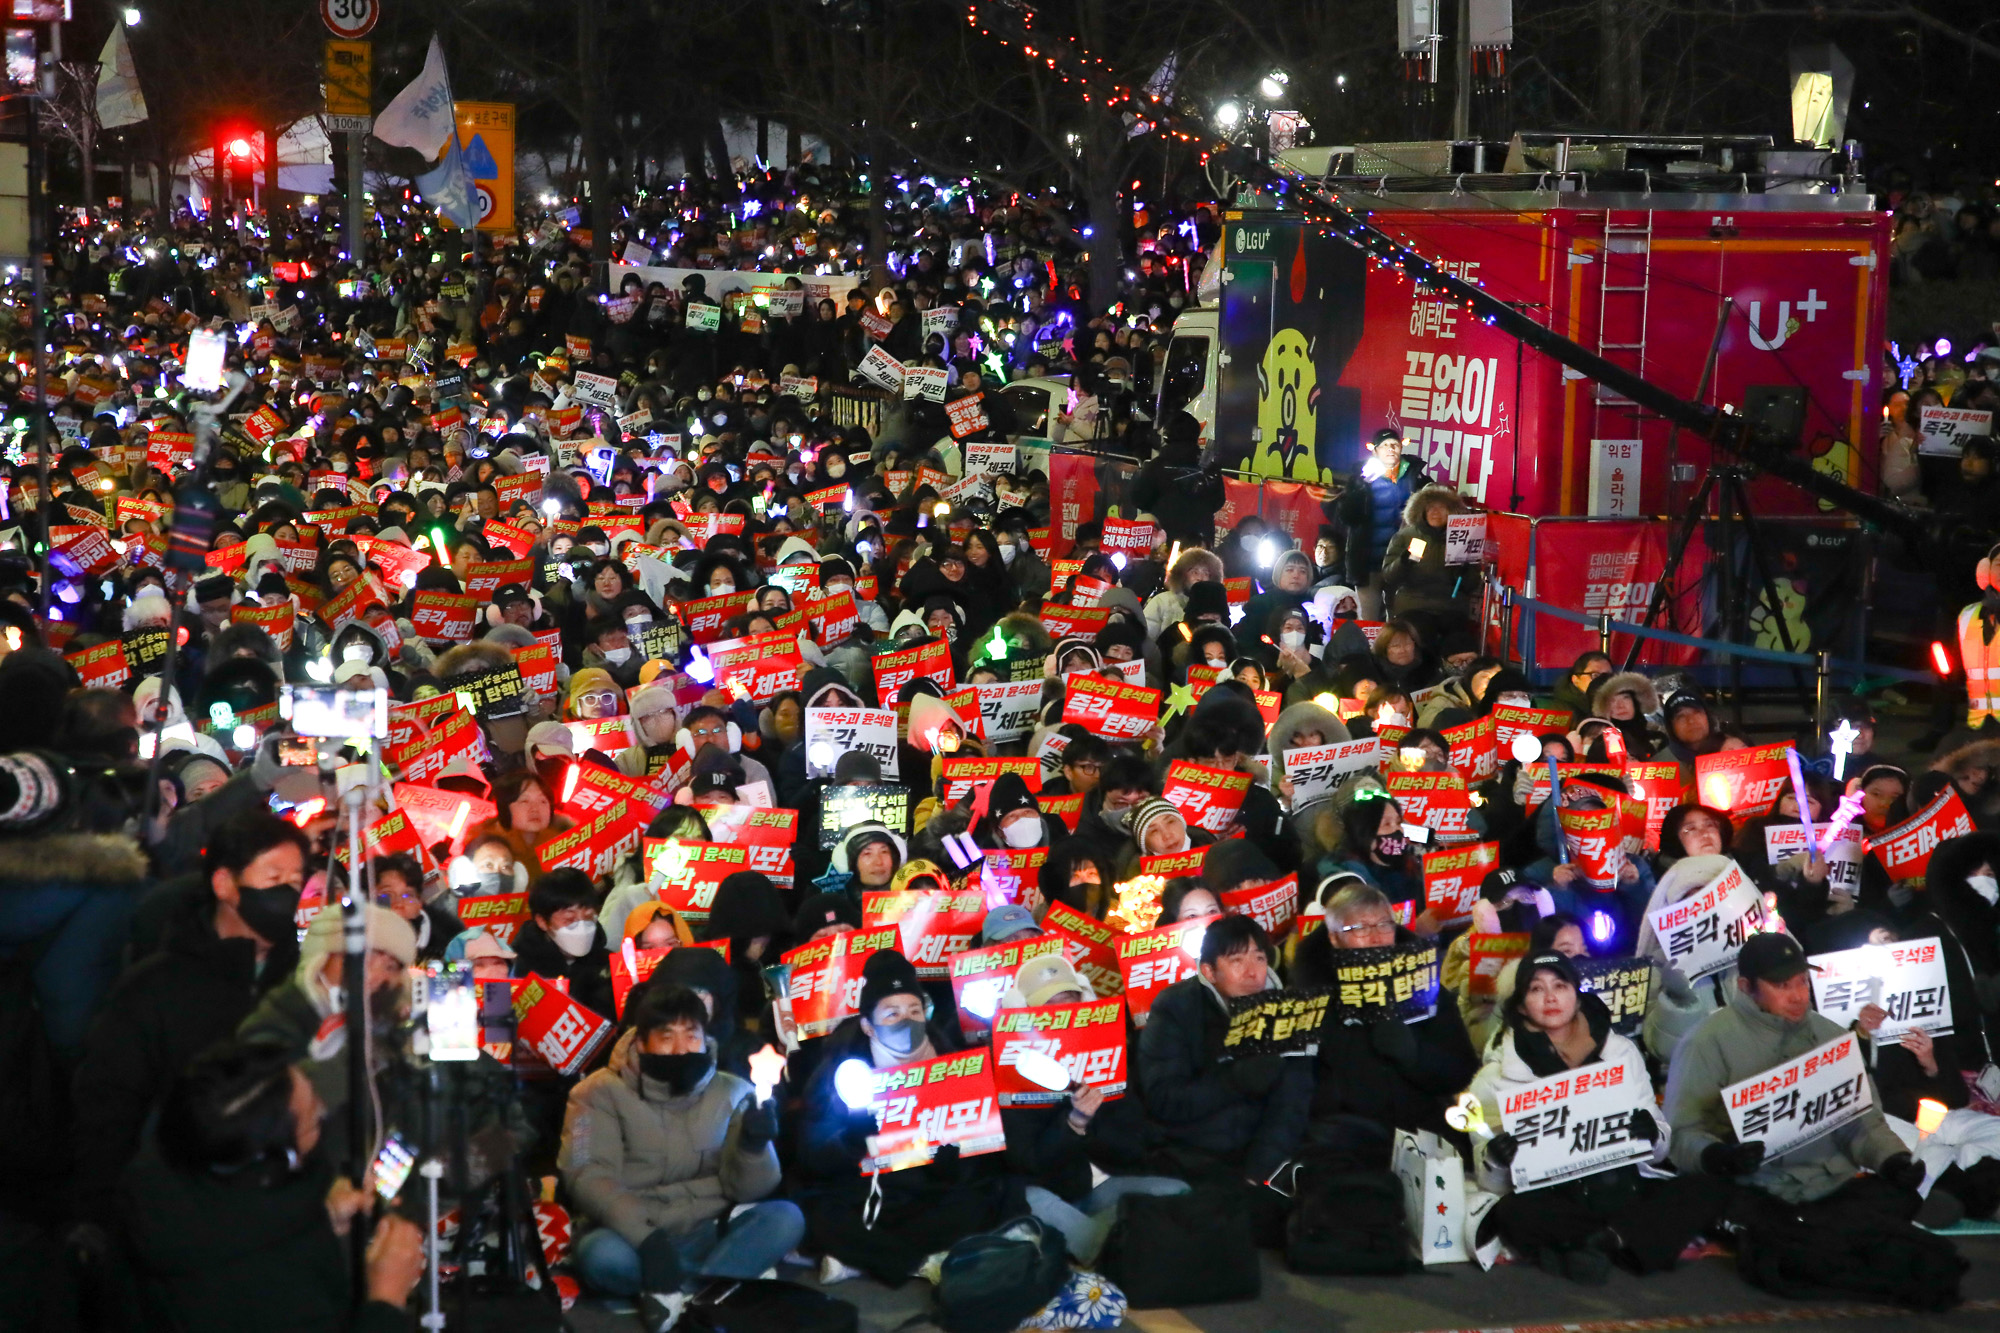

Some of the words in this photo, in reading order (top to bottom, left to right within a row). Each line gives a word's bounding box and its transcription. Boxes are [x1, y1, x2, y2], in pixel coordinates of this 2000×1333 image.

[335, 0, 366, 19] 30
[1410, 301, 1459, 339] 혜택도
[1749, 288, 1828, 351] U+
[866, 354, 888, 372] 즉각
[575, 380, 595, 392] 즉각
[875, 369, 899, 389] 체포!
[905, 375, 924, 387] 즉각
[919, 382, 944, 396] 체포!
[1400, 351, 1498, 428] 끝없이
[949, 405, 981, 424] 윤석열
[1922, 420, 1957, 436] 즉각
[148, 442, 172, 454] 즉각
[168, 450, 194, 463] 체포
[967, 453, 990, 466] 즉각
[985, 461, 1013, 473] 체포!
[499, 486, 522, 501] 즉각
[1610, 467, 1626, 518] 올라가
[1102, 533, 1152, 549] 해체하라!
[1447, 530, 1470, 545] 즉각
[1590, 552, 1640, 566] 데이터도
[468, 576, 500, 591] 즉각
[1583, 582, 1658, 608] 끝없이
[686, 599, 724, 615] 내란수괴
[412, 608, 447, 626] 즉각
[438, 620, 473, 639] 체포!
[690, 613, 722, 632] 즉각
[824, 615, 859, 642] 탄핵!
[1041, 617, 1070, 637] 즉각
[645, 633, 679, 660] 탄핵
[714, 652, 760, 669] 내란수괴
[760, 640, 795, 661] 윤석열
[875, 653, 918, 671] 내란수괴
[918, 643, 946, 661] 윤석열
[492, 669, 520, 684] 윤석열
[754, 669, 801, 697] 체포!
[485, 681, 524, 703] 탄핵!
[1007, 683, 1042, 697] 윤석열
[1070, 677, 1117, 696] 내란수괴
[1117, 687, 1158, 705] 윤석열
[419, 695, 456, 718] 윤석열
[1067, 694, 1113, 717] 즉각
[1100, 713, 1155, 737] 탄핵!
[1494, 707, 1544, 727] 내란수괴
[1544, 712, 1570, 727] 윤석열
[810, 712, 857, 727] 내란수괴
[858, 713, 895, 728] 윤석열
[397, 732, 446, 763] 내란수괴
[1287, 750, 1336, 767] 내란수괴
[1338, 741, 1376, 760] 윤석열
[408, 749, 446, 783] 즉각
[712, 772, 728, 786] DP
[946, 761, 998, 777] 내란수괴
[999, 761, 1037, 776] 윤석열
[1170, 765, 1222, 788] 내란수괴
[1291, 764, 1335, 787] 즉각
[1645, 766, 1677, 780] 윤석열
[583, 767, 632, 796] 내란수괴
[630, 783, 670, 811] 윤석열
[1390, 776, 1435, 790] 내란수괴
[1436, 774, 1466, 790] 윤석열
[878, 793, 908, 808] 윤석열
[1050, 799, 1080, 815] 윤석열
[1166, 785, 1212, 811] 즉각
[751, 811, 794, 829] 윤석열
[1401, 795, 1428, 818] 즉각
[1422, 804, 1470, 832] 체포!
[541, 826, 593, 864] 내란수괴
[594, 799, 628, 834] 윤석열
[1885, 820, 1938, 869] 체포!
[704, 845, 746, 866] 윤석열
[1568, 834, 1607, 862] 즉각
[1145, 851, 1205, 876] 내란수괴
[1426, 853, 1466, 875] 내란수괴
[1427, 875, 1463, 904] 즉각
[1499, 869, 1517, 886] DP
[936, 895, 983, 913] 윤석열
[1251, 881, 1297, 910] 국민의힘
[1658, 891, 1716, 932] 내란수괴
[1716, 865, 1742, 902] 윤석열
[461, 898, 520, 920] 내란수괴
[1048, 908, 1113, 944] 내란수괴
[1669, 911, 1720, 957] 즉각
[787, 939, 848, 971] 내란수괴
[850, 929, 897, 955] 윤석열
[953, 945, 1018, 978] 내란수괴
[1022, 938, 1064, 962] 윤석열
[1890, 944, 1937, 968] 윤석열
[1128, 954, 1181, 990] 즉각
[1337, 965, 1392, 982] 내란수괴
[1405, 947, 1437, 972] 윤석열
[1619, 966, 1650, 985] 윤석열
[790, 966, 842, 1001] 즉각
[1339, 980, 1388, 1008] 즉각
[1393, 964, 1438, 1003] 탄핵!
[1885, 985, 1946, 1023] 체포!
[995, 1010, 1071, 1033] 내란수괴
[1070, 1002, 1121, 1029] 윤석열
[1224, 1017, 1267, 1048] 즉각
[1272, 1009, 1326, 1041] 탄핵!
[535, 1002, 593, 1071] 체포!
[928, 1054, 986, 1082] 윤석열
[1731, 1069, 1799, 1110] 내란수괴
[1803, 1040, 1852, 1078] 윤석열
[1505, 1079, 1570, 1115] 내란수괴
[1574, 1064, 1625, 1095] 윤석열
[1741, 1089, 1802, 1139] 즉각
[1800, 1072, 1865, 1130] 체포!
[917, 1095, 993, 1144] 체포!
[1514, 1104, 1571, 1149] 즉각
